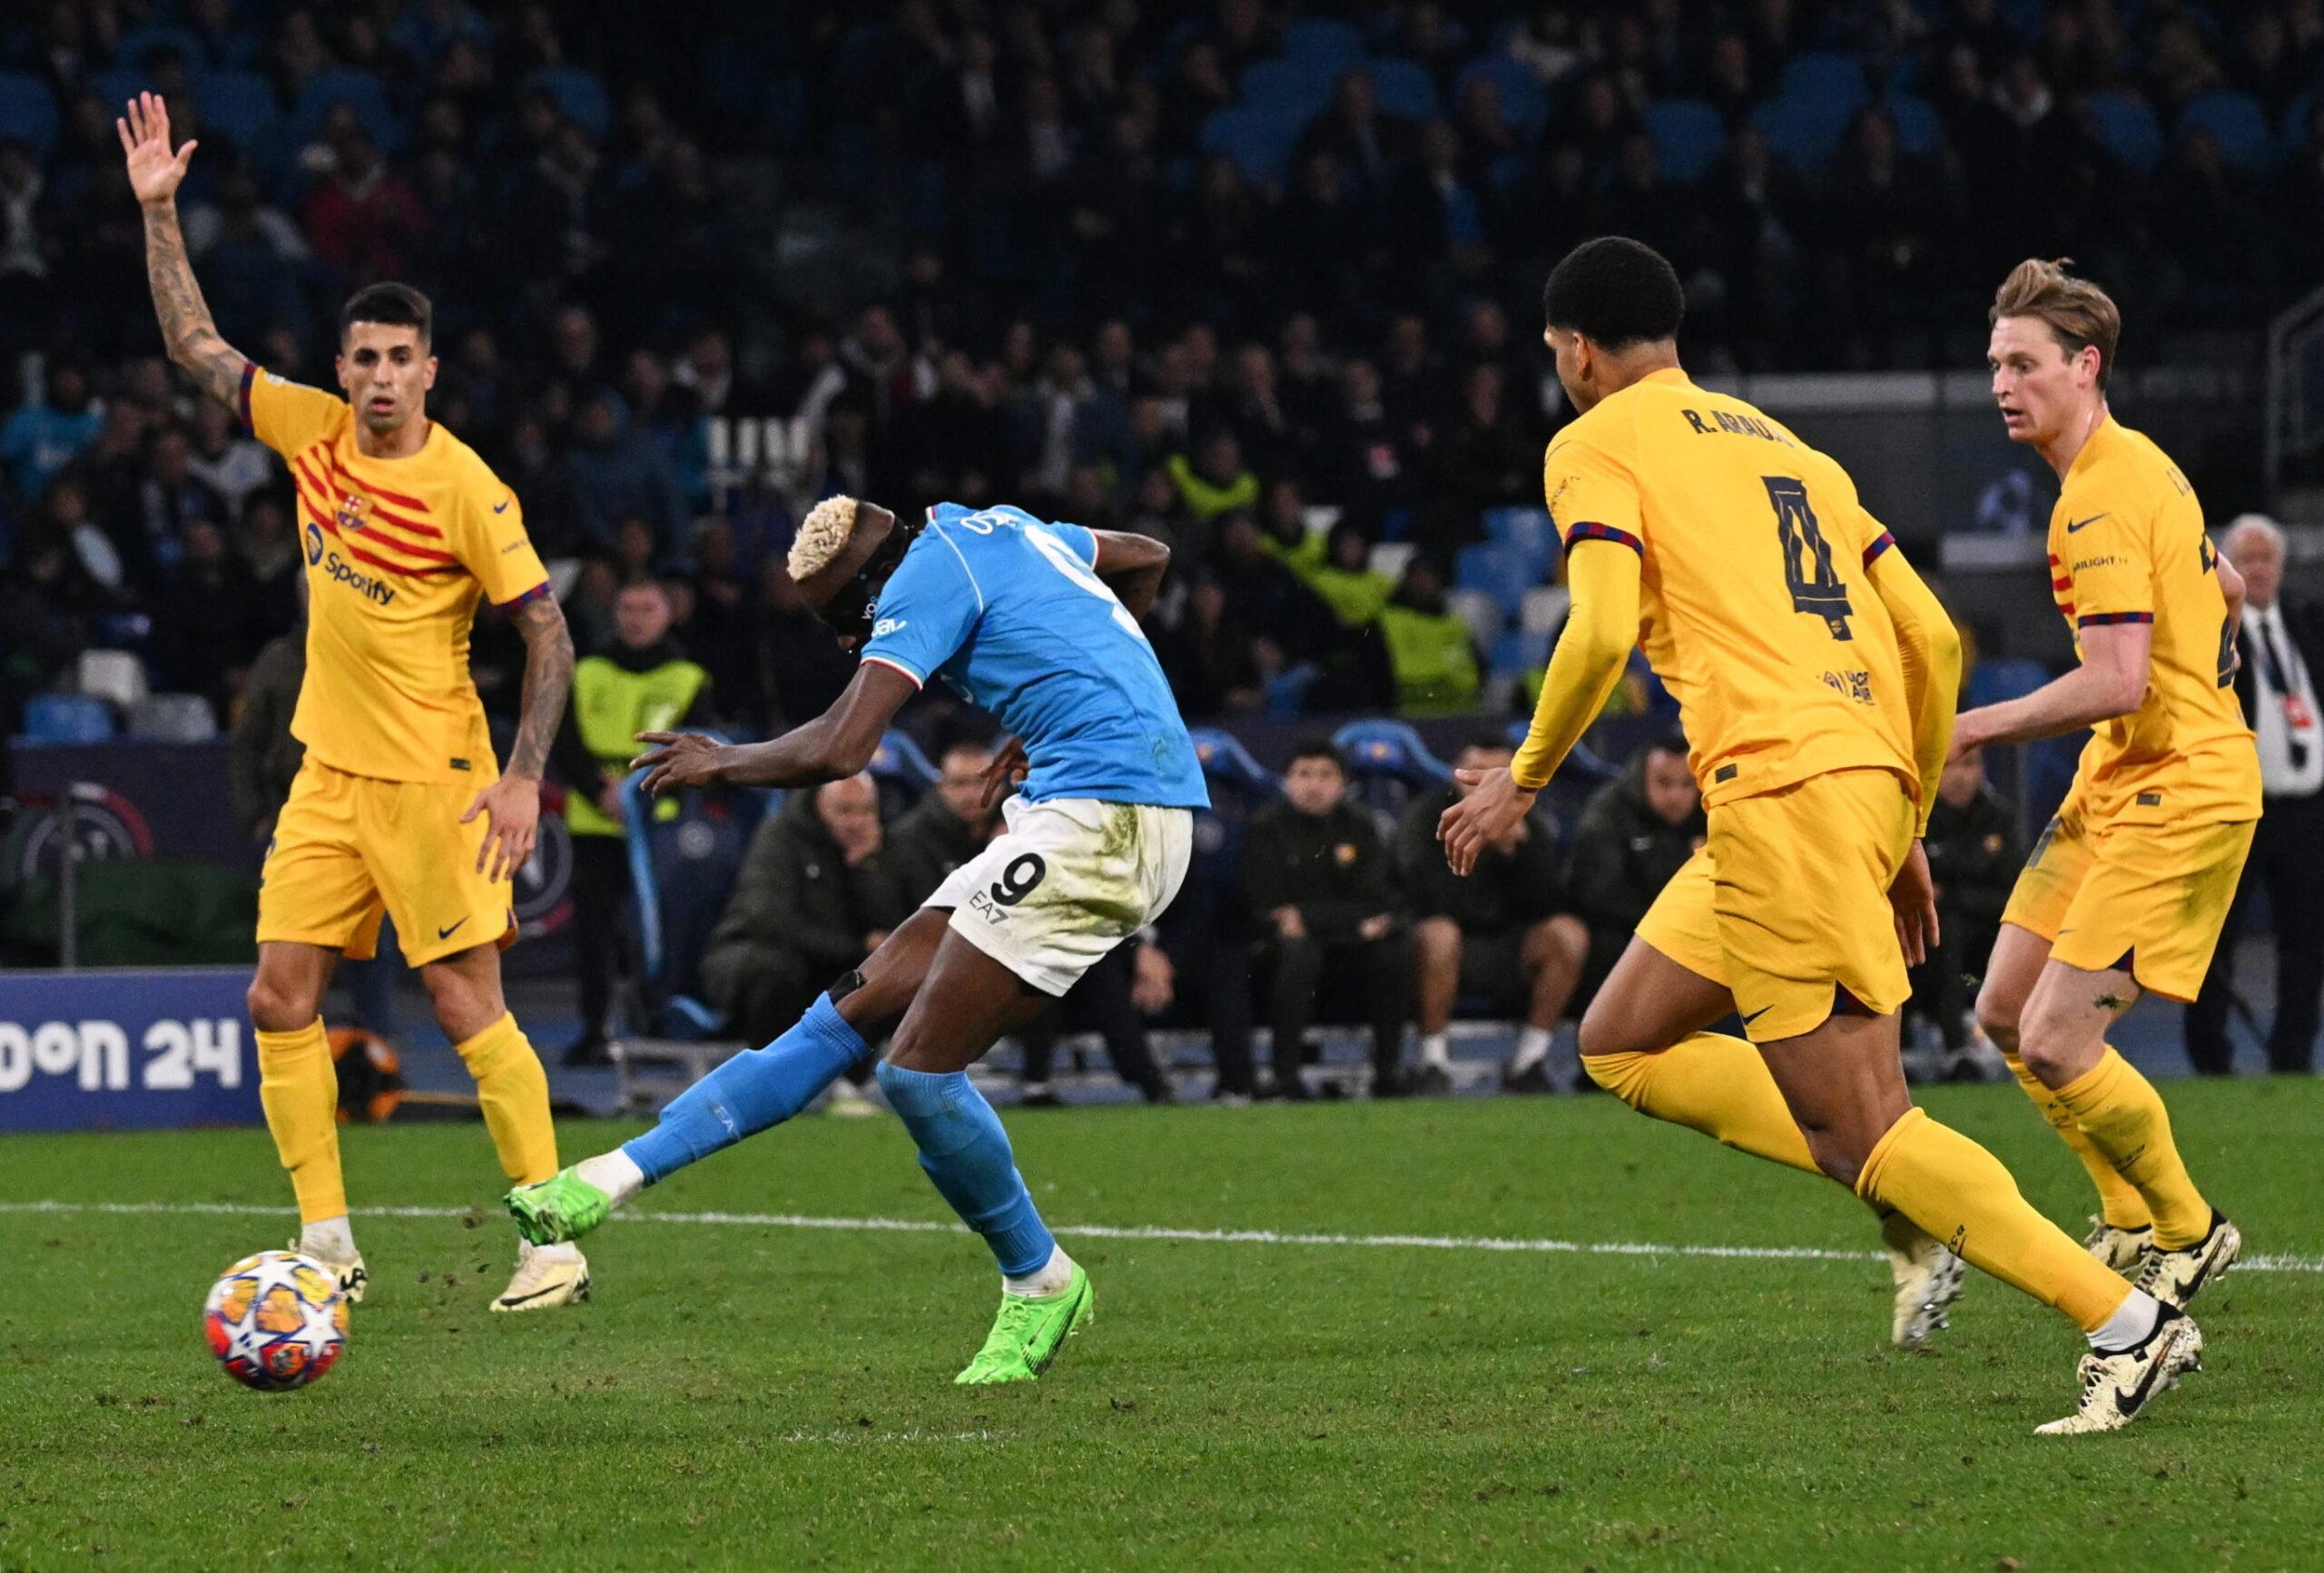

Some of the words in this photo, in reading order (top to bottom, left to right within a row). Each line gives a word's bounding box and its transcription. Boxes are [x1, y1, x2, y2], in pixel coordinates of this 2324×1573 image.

[1710, 409, 1795, 447] ARAU
[324, 552, 396, 605] Spoify
[1760, 476, 1854, 641] 4
[990, 851, 1046, 906] 9
[969, 890, 1009, 925] EA7
[143, 1018, 242, 1090] 24
